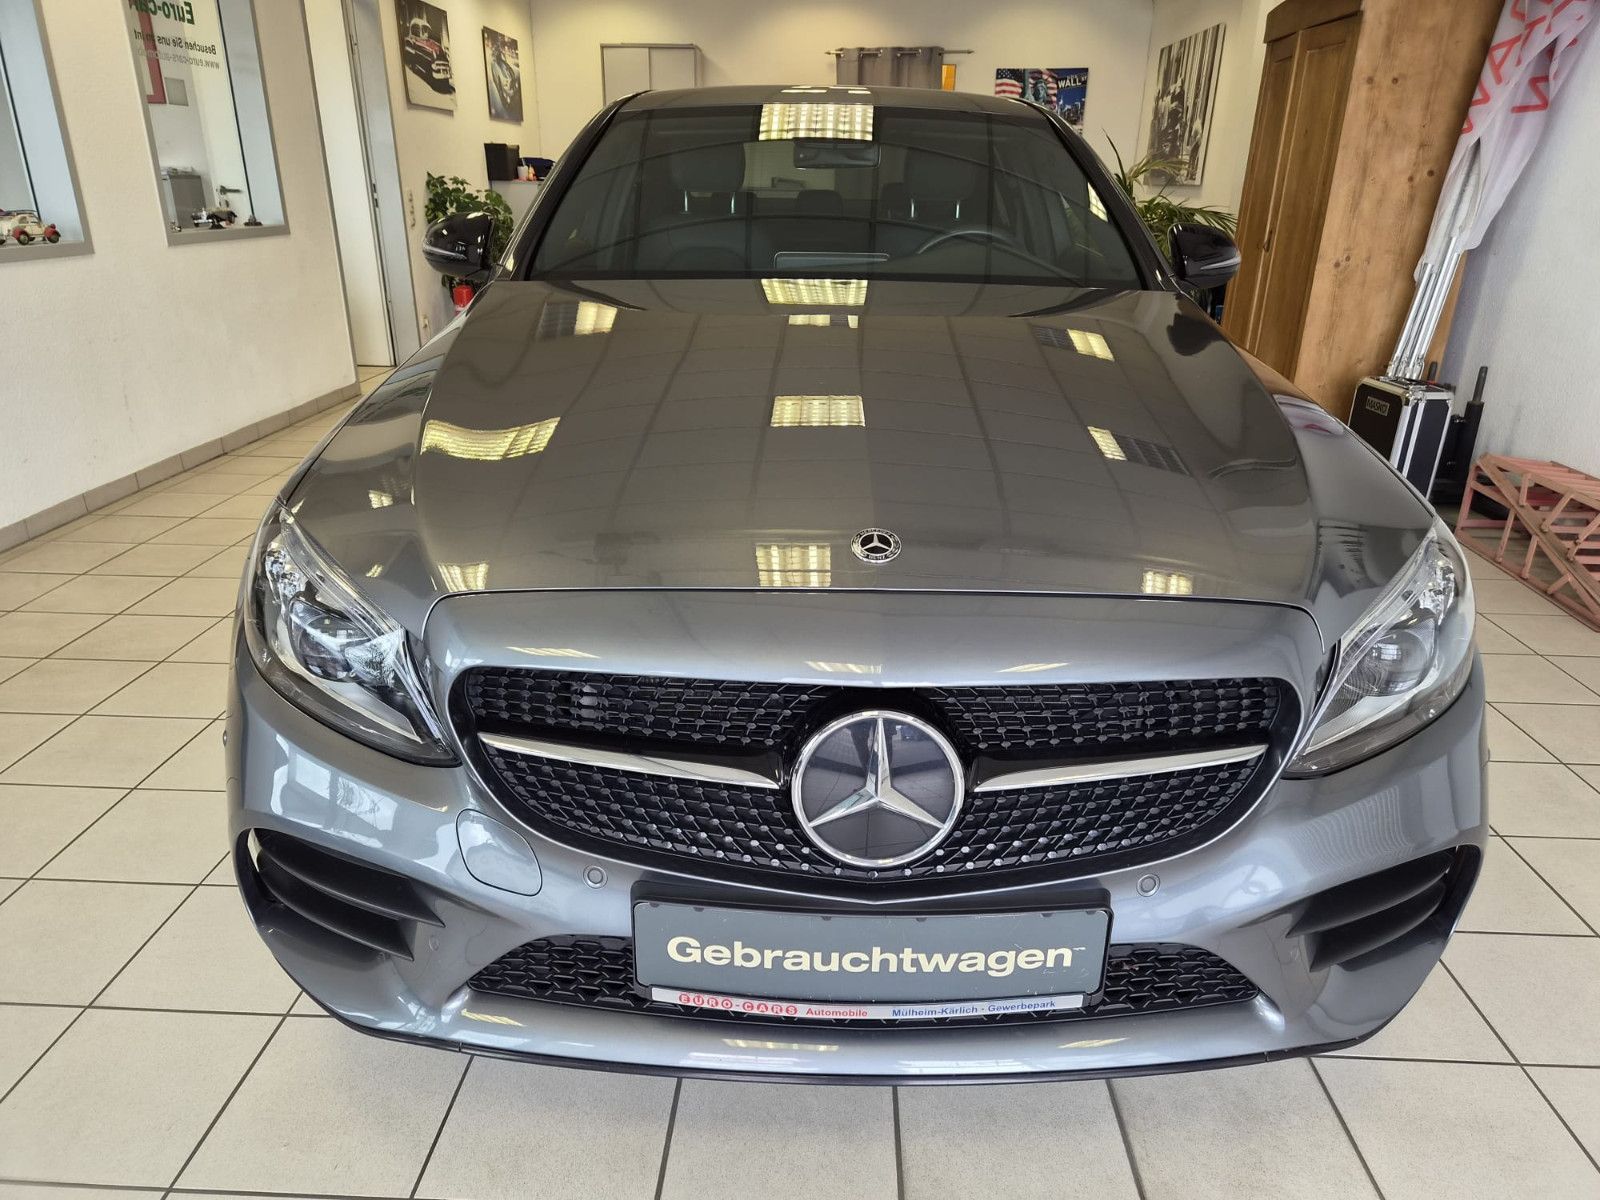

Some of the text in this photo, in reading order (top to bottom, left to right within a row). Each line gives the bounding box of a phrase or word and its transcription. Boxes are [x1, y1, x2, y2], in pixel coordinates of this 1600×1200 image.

[1058, 77, 1081, 88] WALL
[666, 935, 1073, 977] Gebrauchtwagen
[806, 1007, 868, 1018] Automobile
[892, 1006, 978, 1017] Mülheim-Kärlich
[988, 1001, 1056, 1013] Gewerbepark
